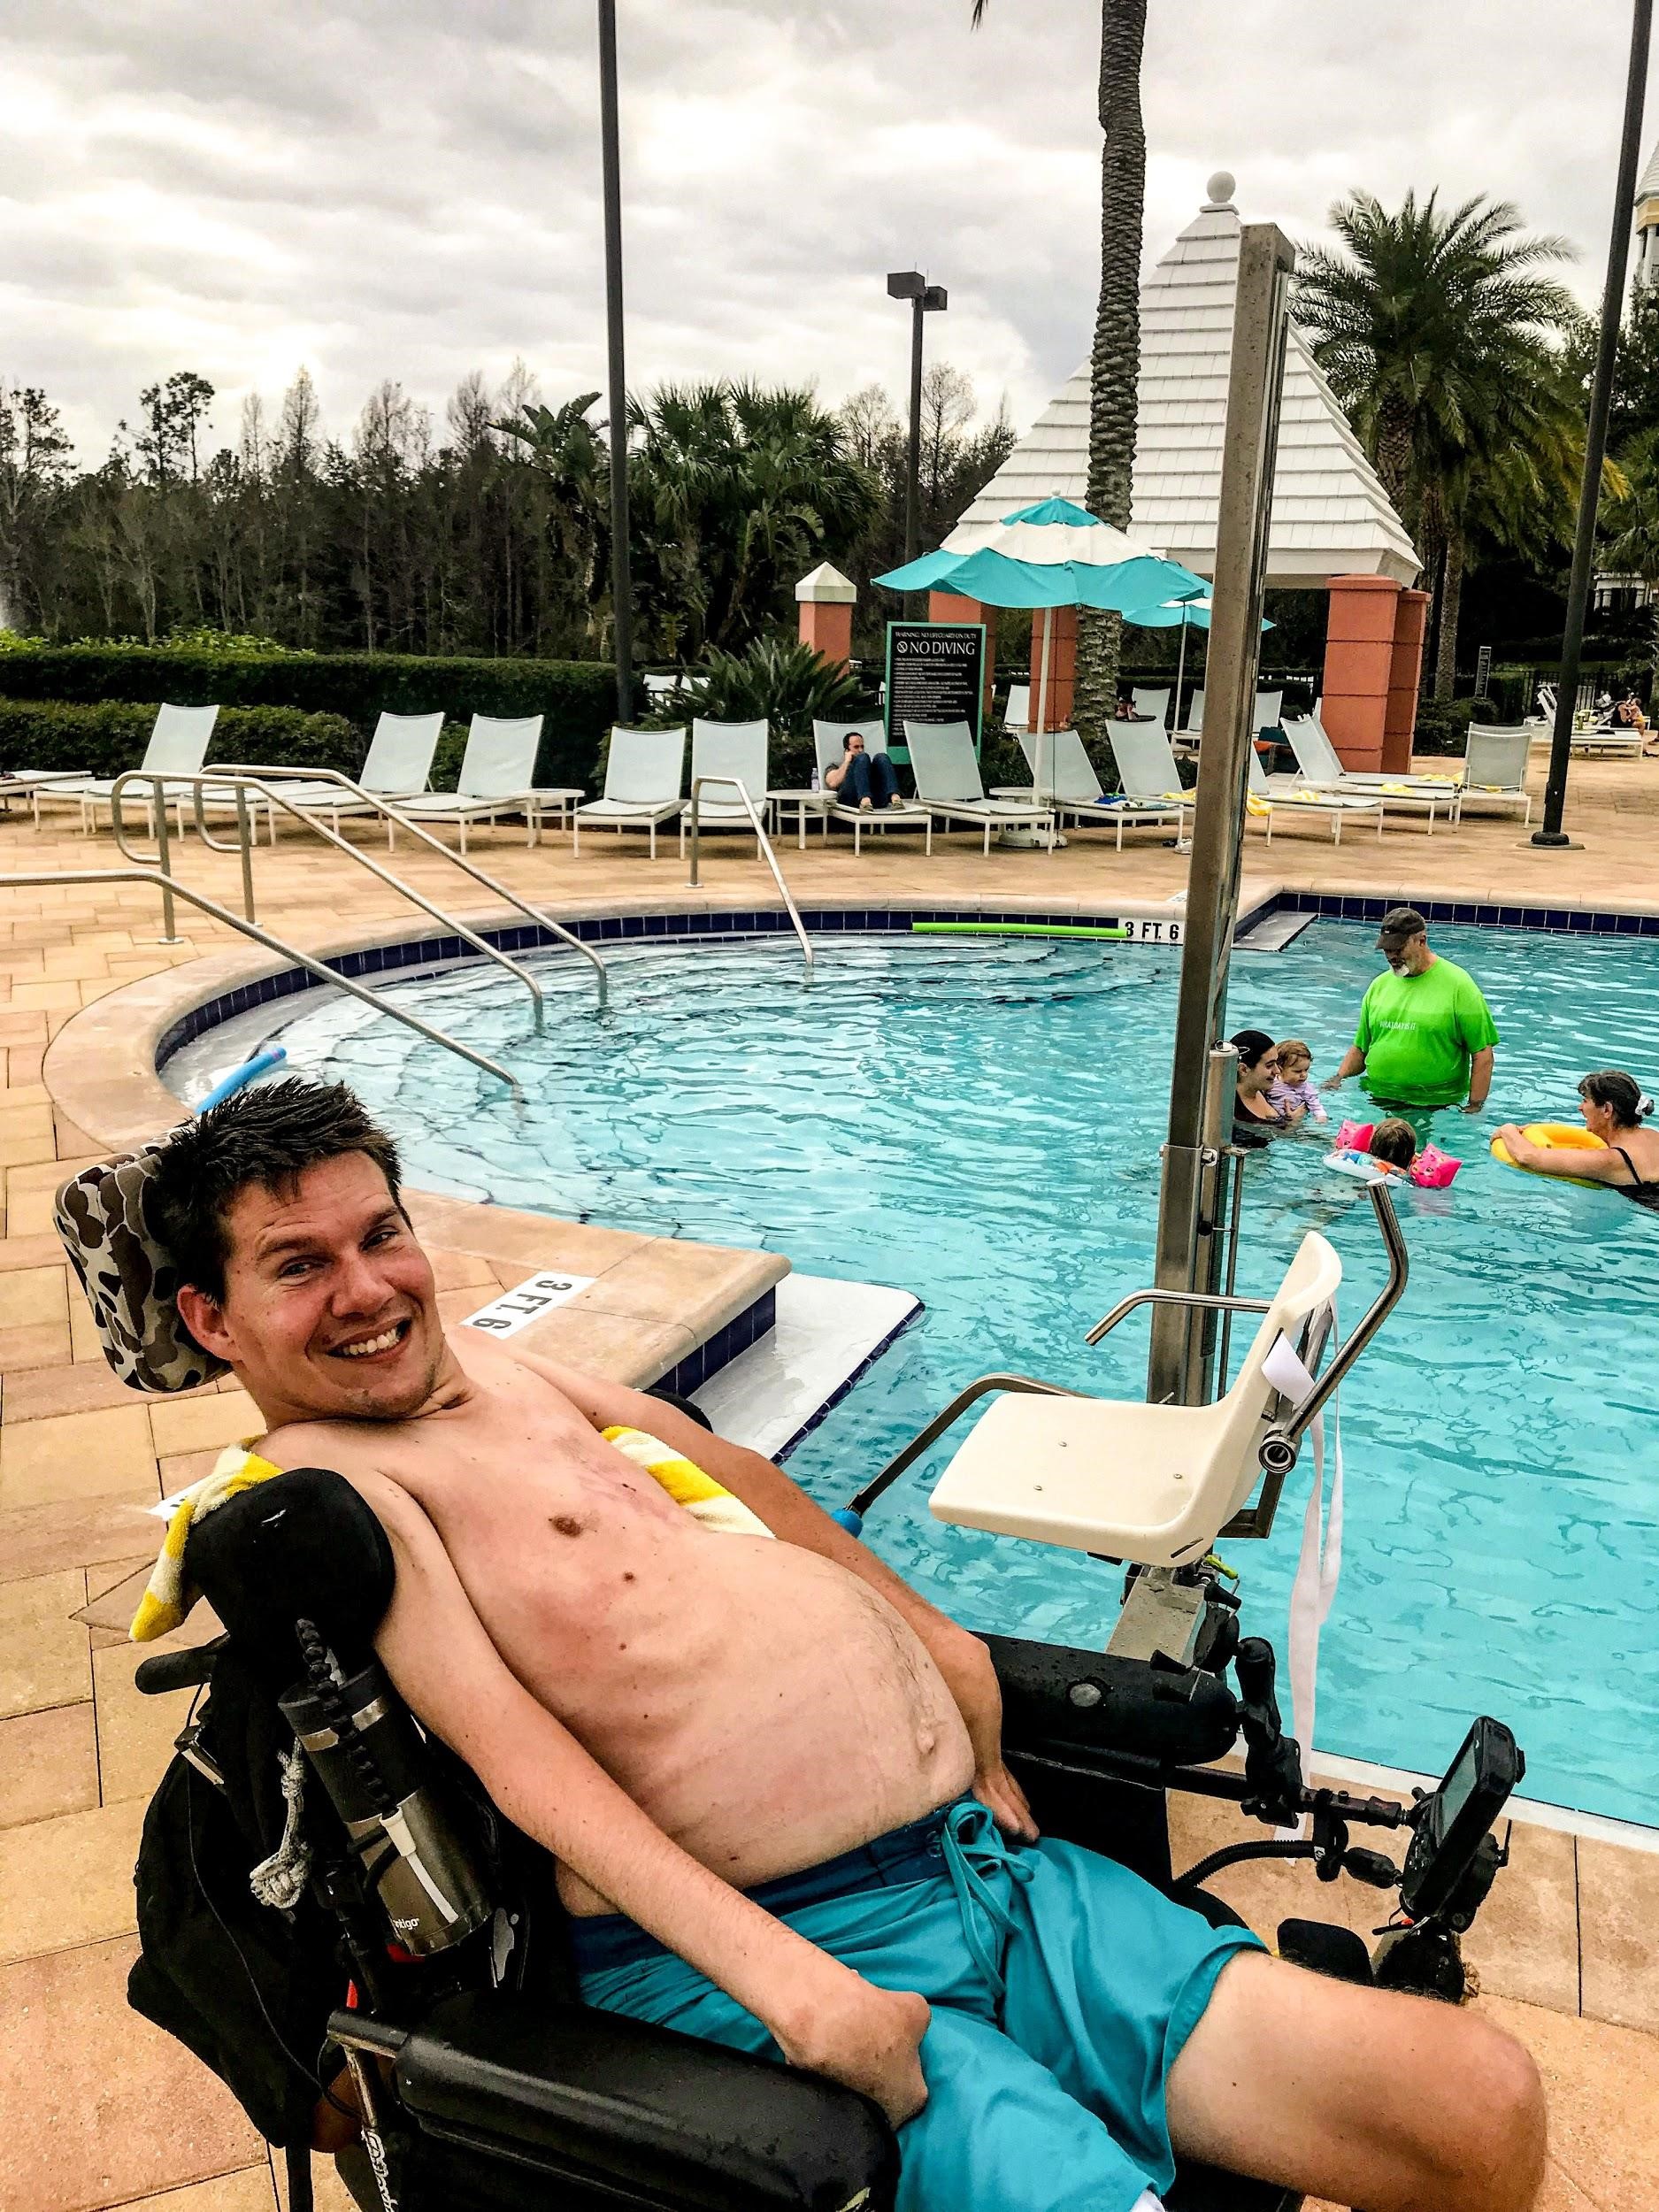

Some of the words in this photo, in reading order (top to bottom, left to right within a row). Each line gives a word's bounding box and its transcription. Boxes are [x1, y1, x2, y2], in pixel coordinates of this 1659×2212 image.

[910, 641, 930, 654] NO
[932, 641, 976, 655] DIVING
[1125, 921, 1134, 937] 3
[1141, 922, 1163, 940] FT.
[1169, 924, 1179, 940] 6
[535, 1279, 573, 1291] 3
[495, 1293, 553, 1315] FT.
[472, 1317, 512, 1330] 6
